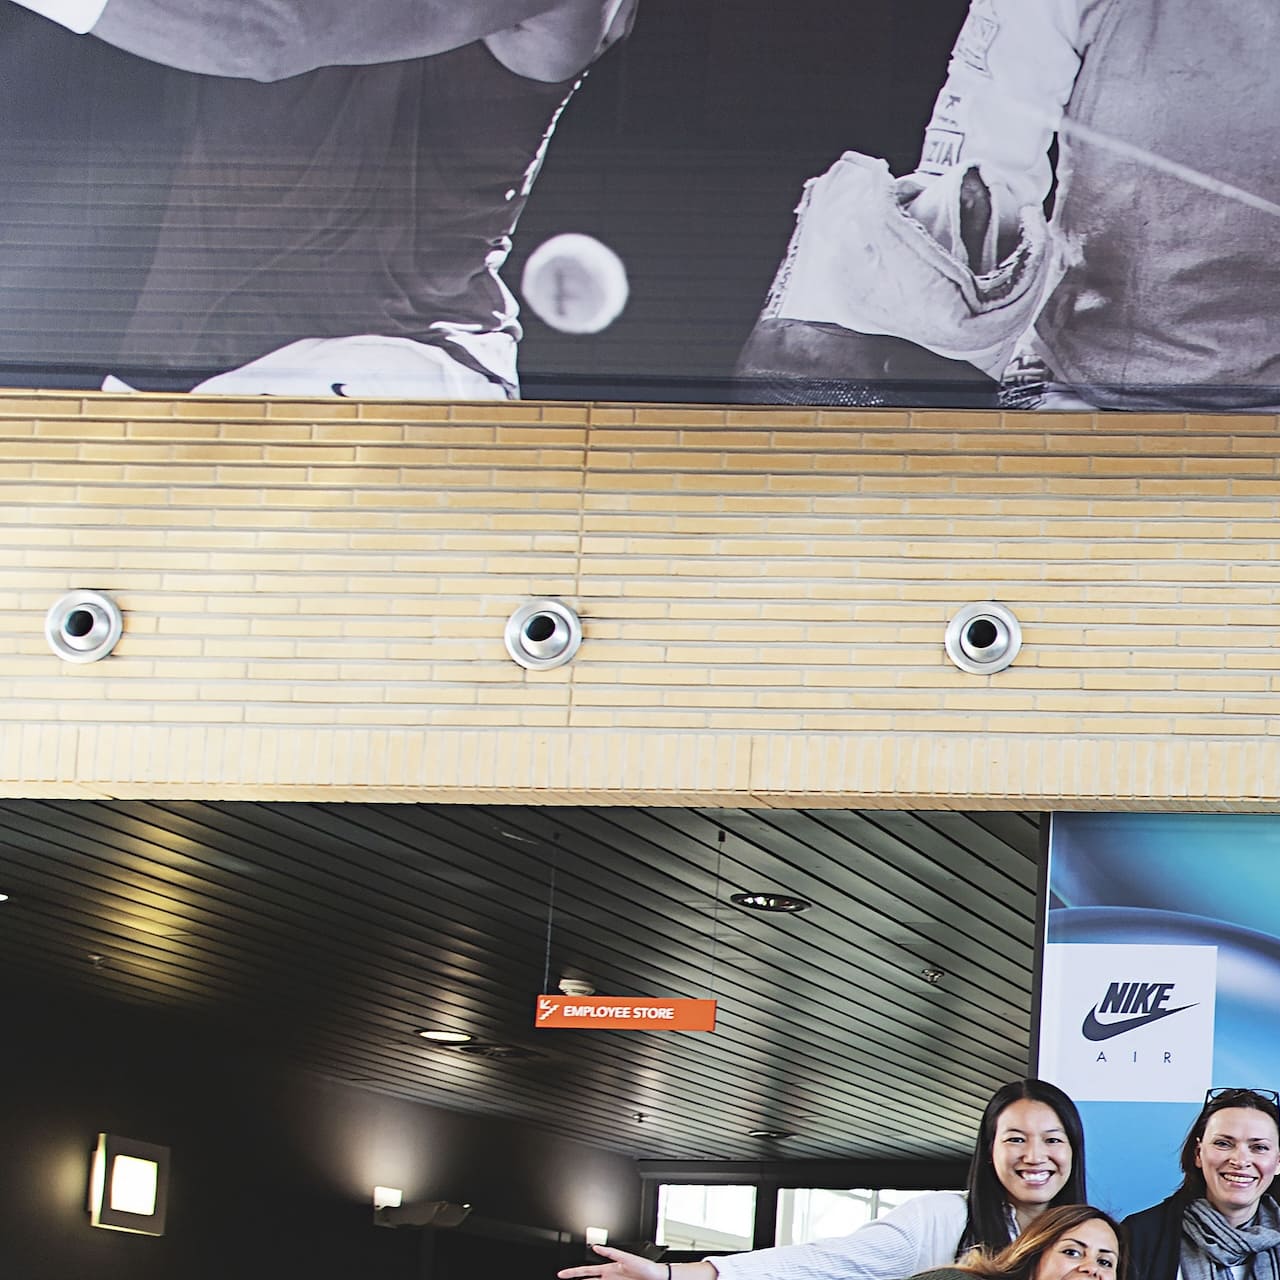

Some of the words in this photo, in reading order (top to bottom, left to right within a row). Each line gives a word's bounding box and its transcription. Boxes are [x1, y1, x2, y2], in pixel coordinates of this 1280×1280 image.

[1098, 982, 1176, 1015] NIKE
[563, 1005, 631, 1018] EMPLOYEE
[633, 1007, 674, 1019] STORE
[1096, 1051, 1172, 1064] AIR
